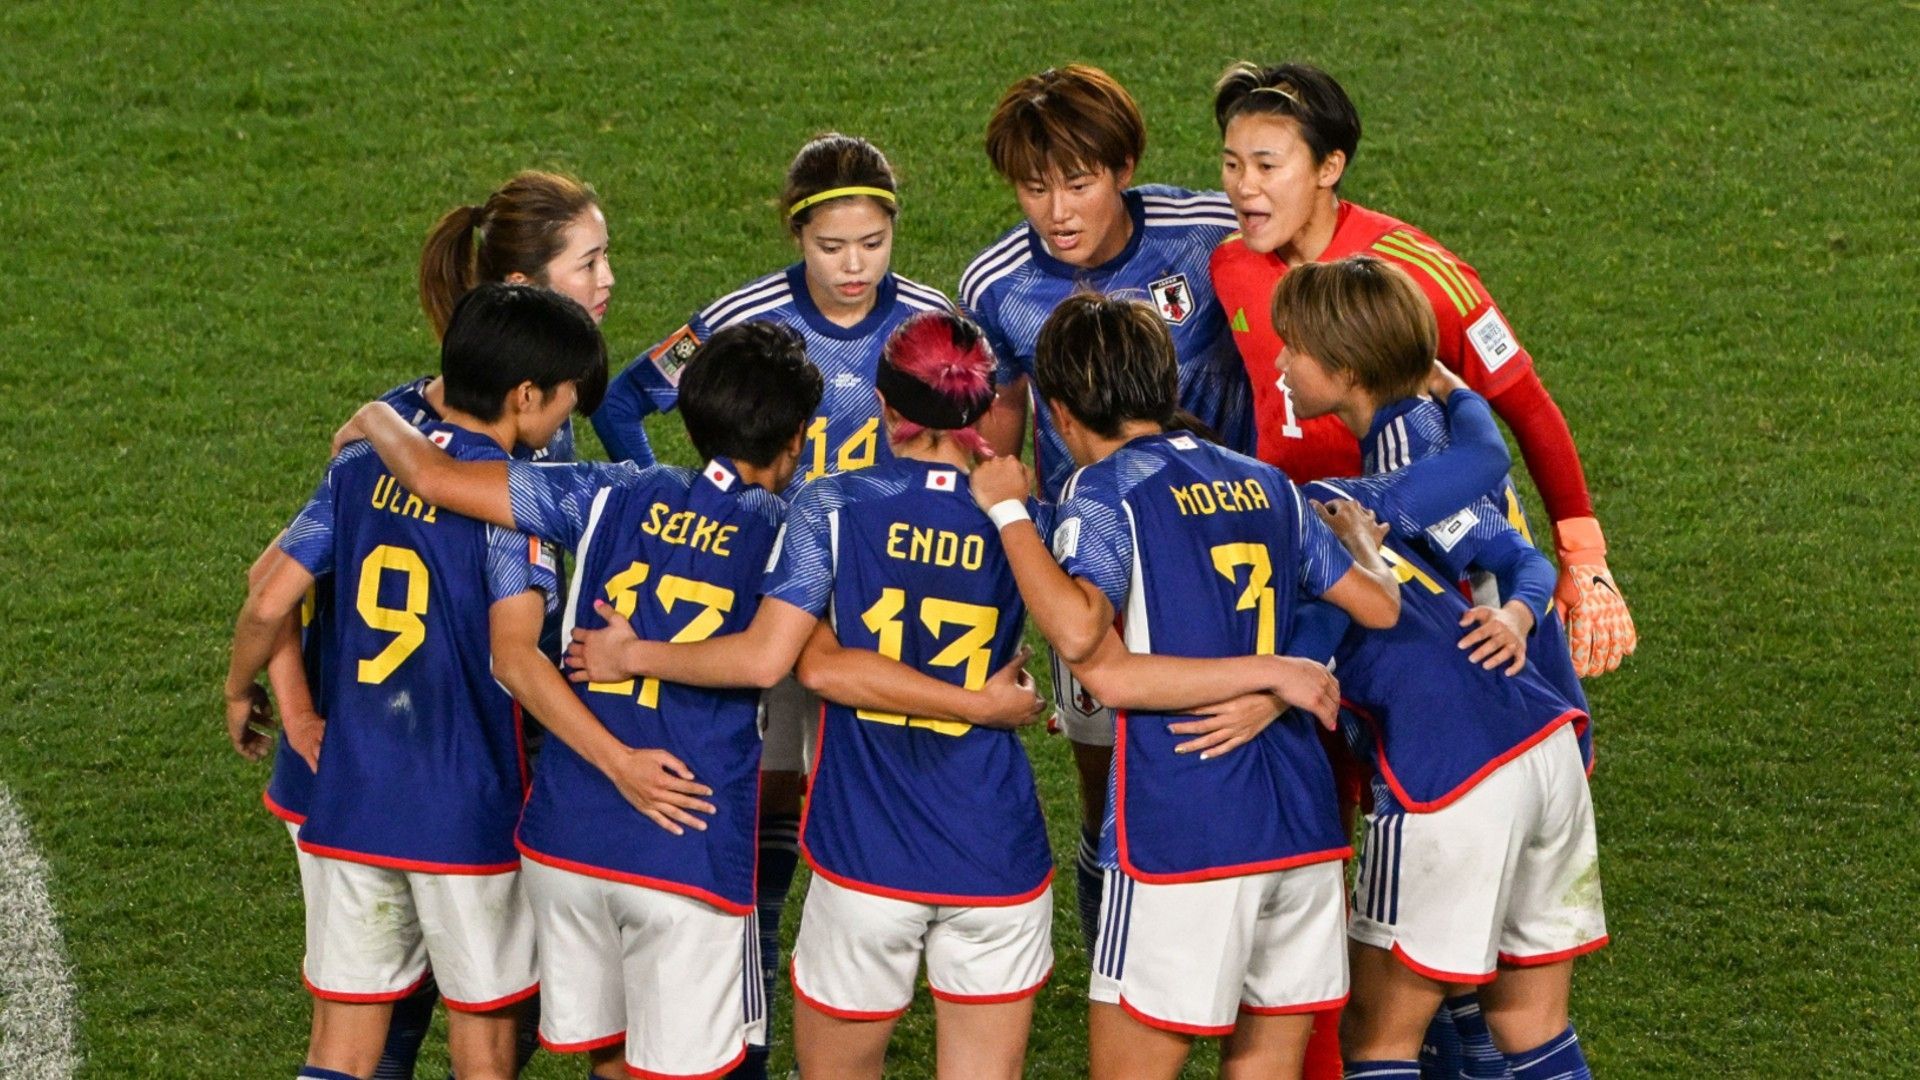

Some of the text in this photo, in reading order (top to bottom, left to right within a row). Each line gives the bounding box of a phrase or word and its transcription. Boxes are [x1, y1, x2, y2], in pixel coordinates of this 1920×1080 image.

[805, 417, 879, 481] 14
[1169, 479, 1270, 515] MOEKA
[641, 502, 739, 557] SEIKE
[887, 522, 984, 570] ENDO
[357, 544, 429, 685] 9
[588, 561, 735, 709] 17
[857, 588, 999, 737] 13
